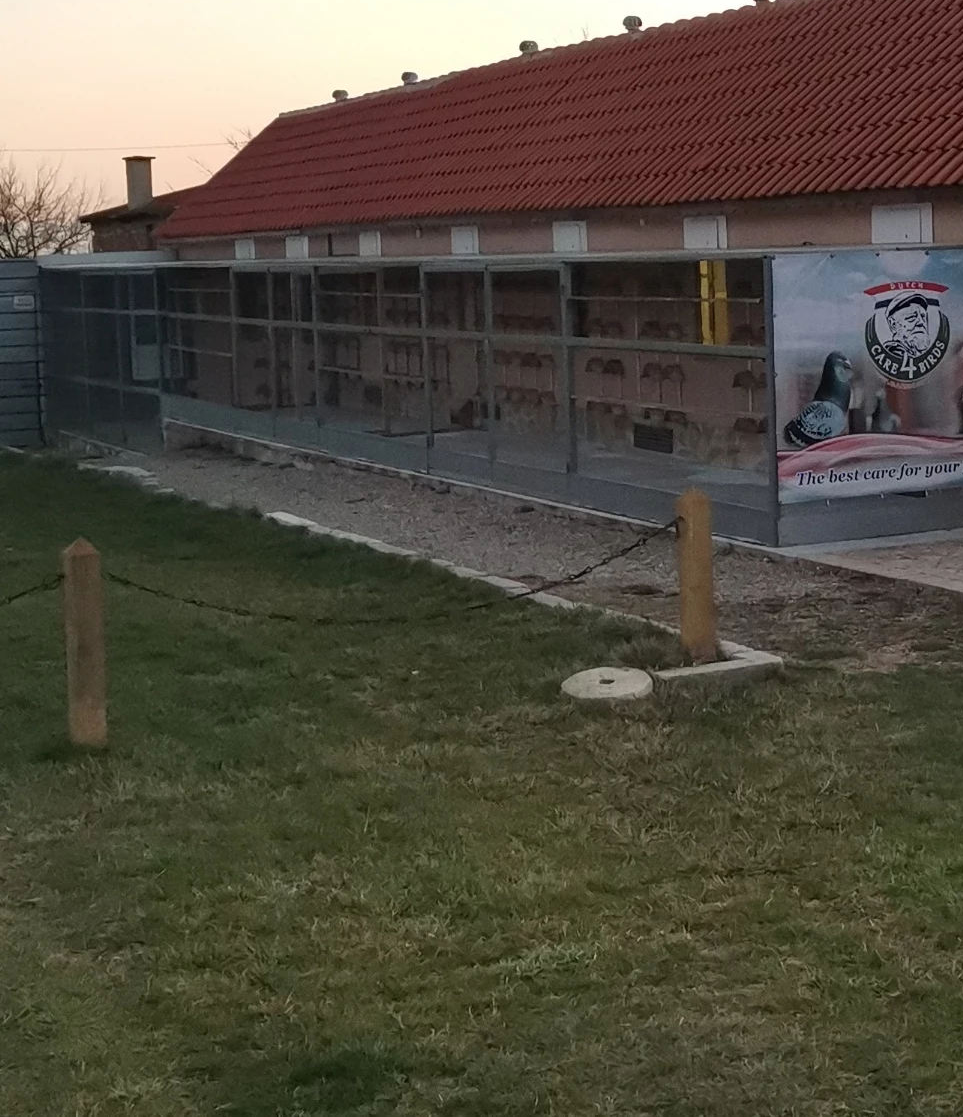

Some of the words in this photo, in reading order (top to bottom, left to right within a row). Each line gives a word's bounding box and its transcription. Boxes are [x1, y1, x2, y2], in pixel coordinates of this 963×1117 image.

[871, 344, 899, 375] CARE
[900, 350, 917, 379] 4
[918, 340, 946, 374] BIRDS
[796, 471, 825, 486] The
[829, 469, 859, 483] best
[863, 468, 896, 481] care
[895, 462, 922, 480] for
[925, 462, 961, 477] your
